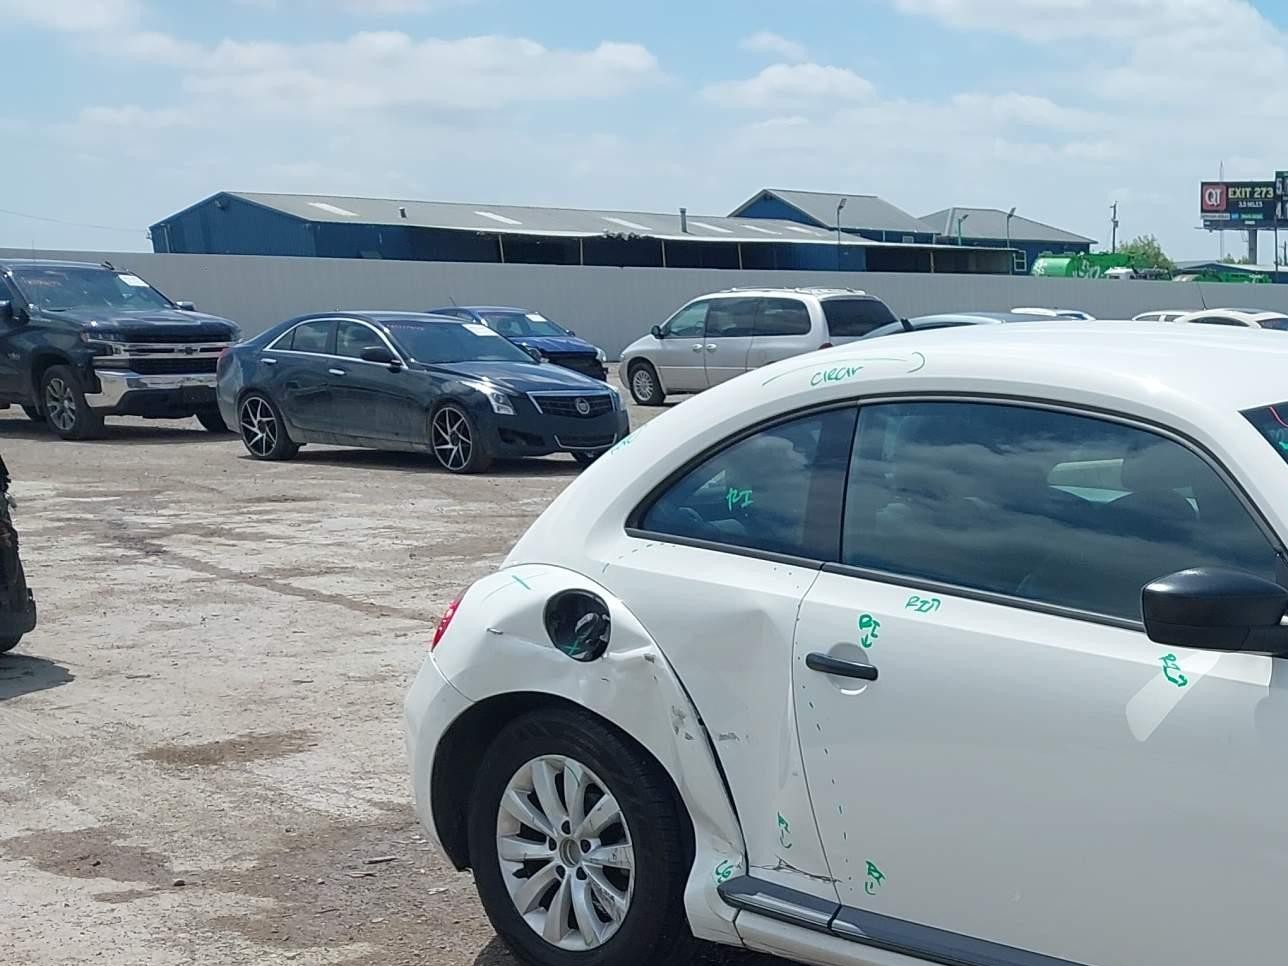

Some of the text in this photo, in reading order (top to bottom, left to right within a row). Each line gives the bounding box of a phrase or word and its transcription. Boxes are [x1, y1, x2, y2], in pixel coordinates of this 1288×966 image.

[1205, 189, 1221, 206] QT
[1228, 187, 1274, 198] EXIT 273
